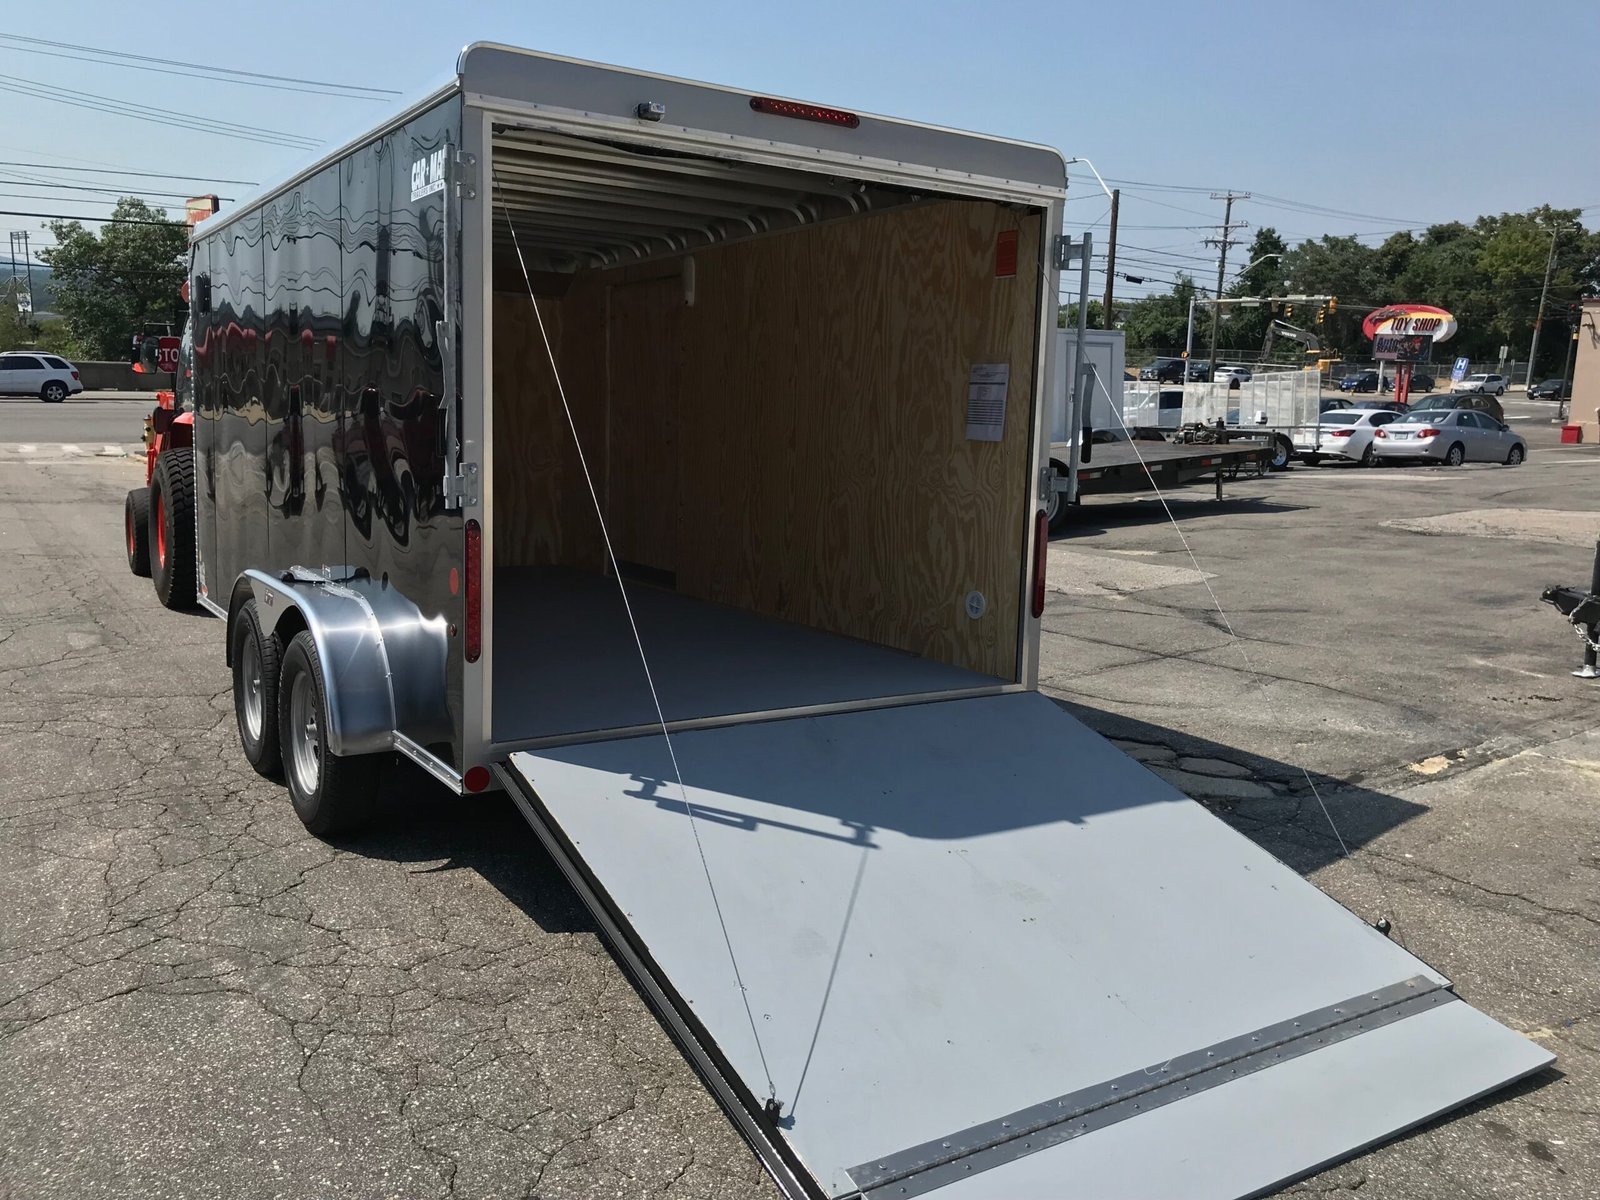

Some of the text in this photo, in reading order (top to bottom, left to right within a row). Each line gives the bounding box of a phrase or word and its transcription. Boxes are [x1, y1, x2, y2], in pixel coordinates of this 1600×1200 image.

[430, 148, 445, 184] MA
[1391, 317, 1441, 331] TOY SHOP
[158, 348, 180, 362] STO
[1456, 359, 1467, 370] H
